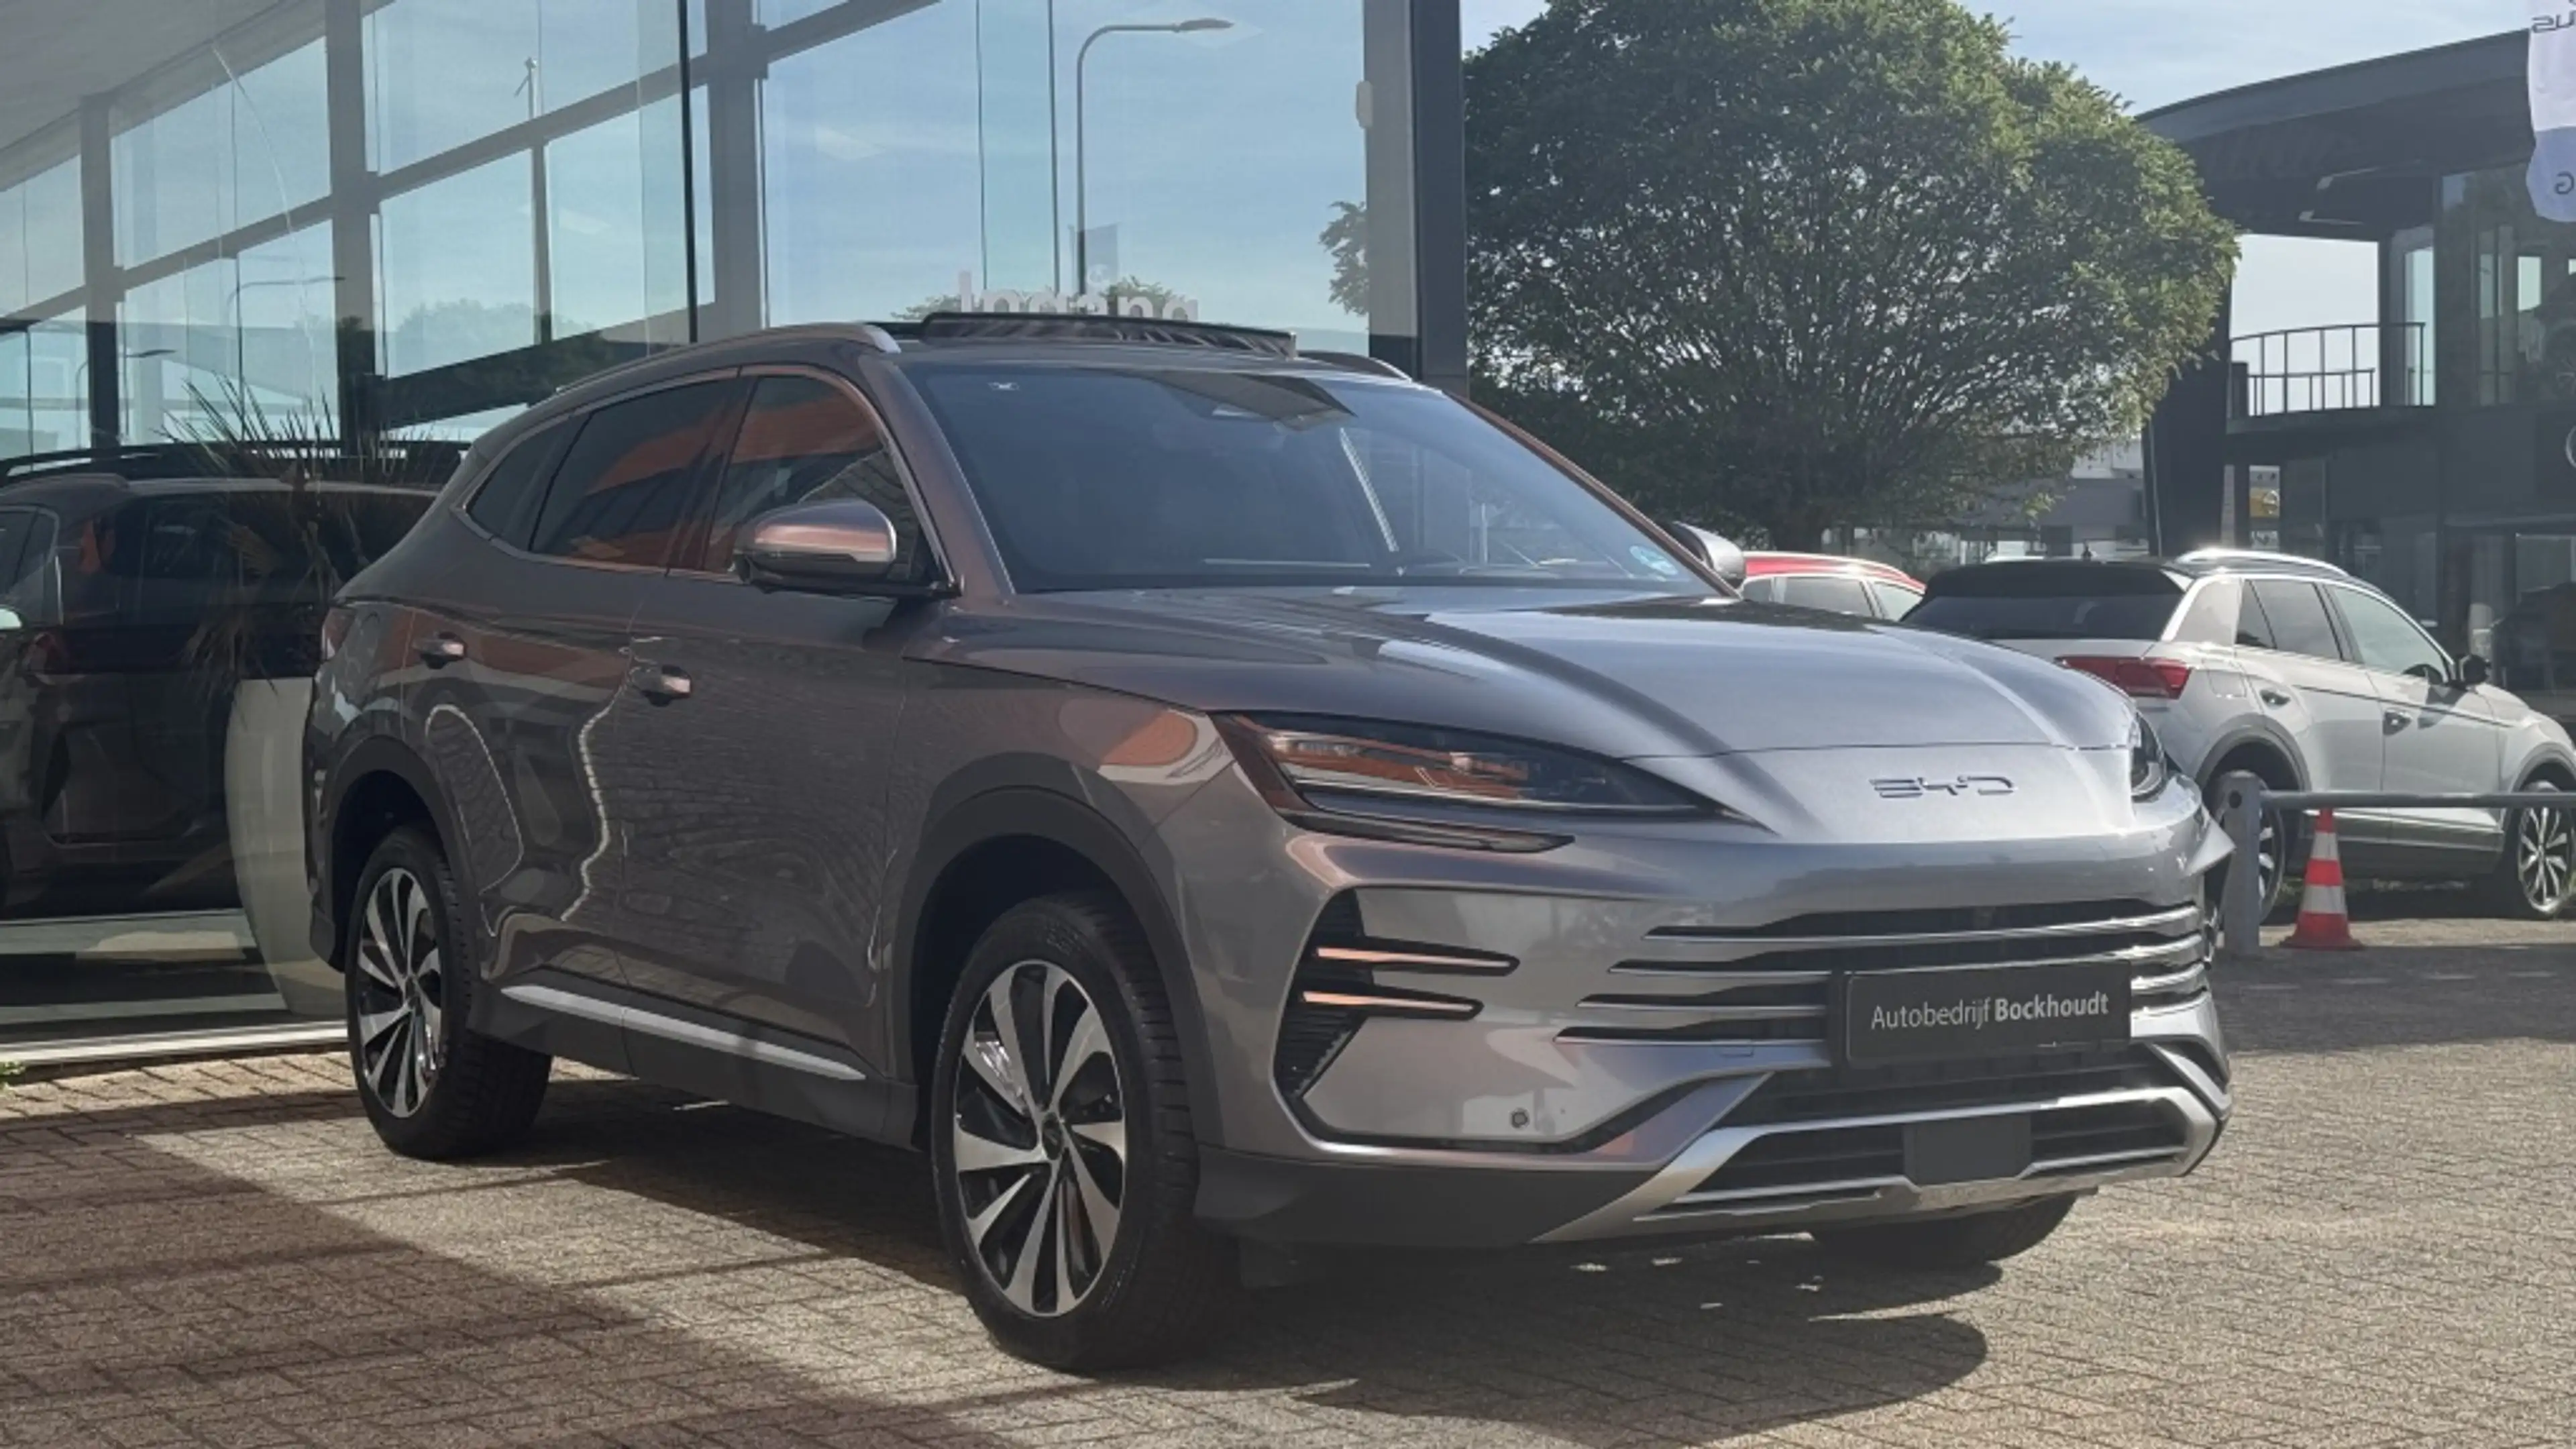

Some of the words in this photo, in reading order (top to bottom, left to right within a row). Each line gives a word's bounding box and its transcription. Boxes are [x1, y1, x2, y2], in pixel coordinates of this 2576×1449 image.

[1868, 776, 2015, 798] BYD
[1871, 998, 1994, 1030] Autobedrijf
[1994, 990, 2109, 1022] Bockhoudt
